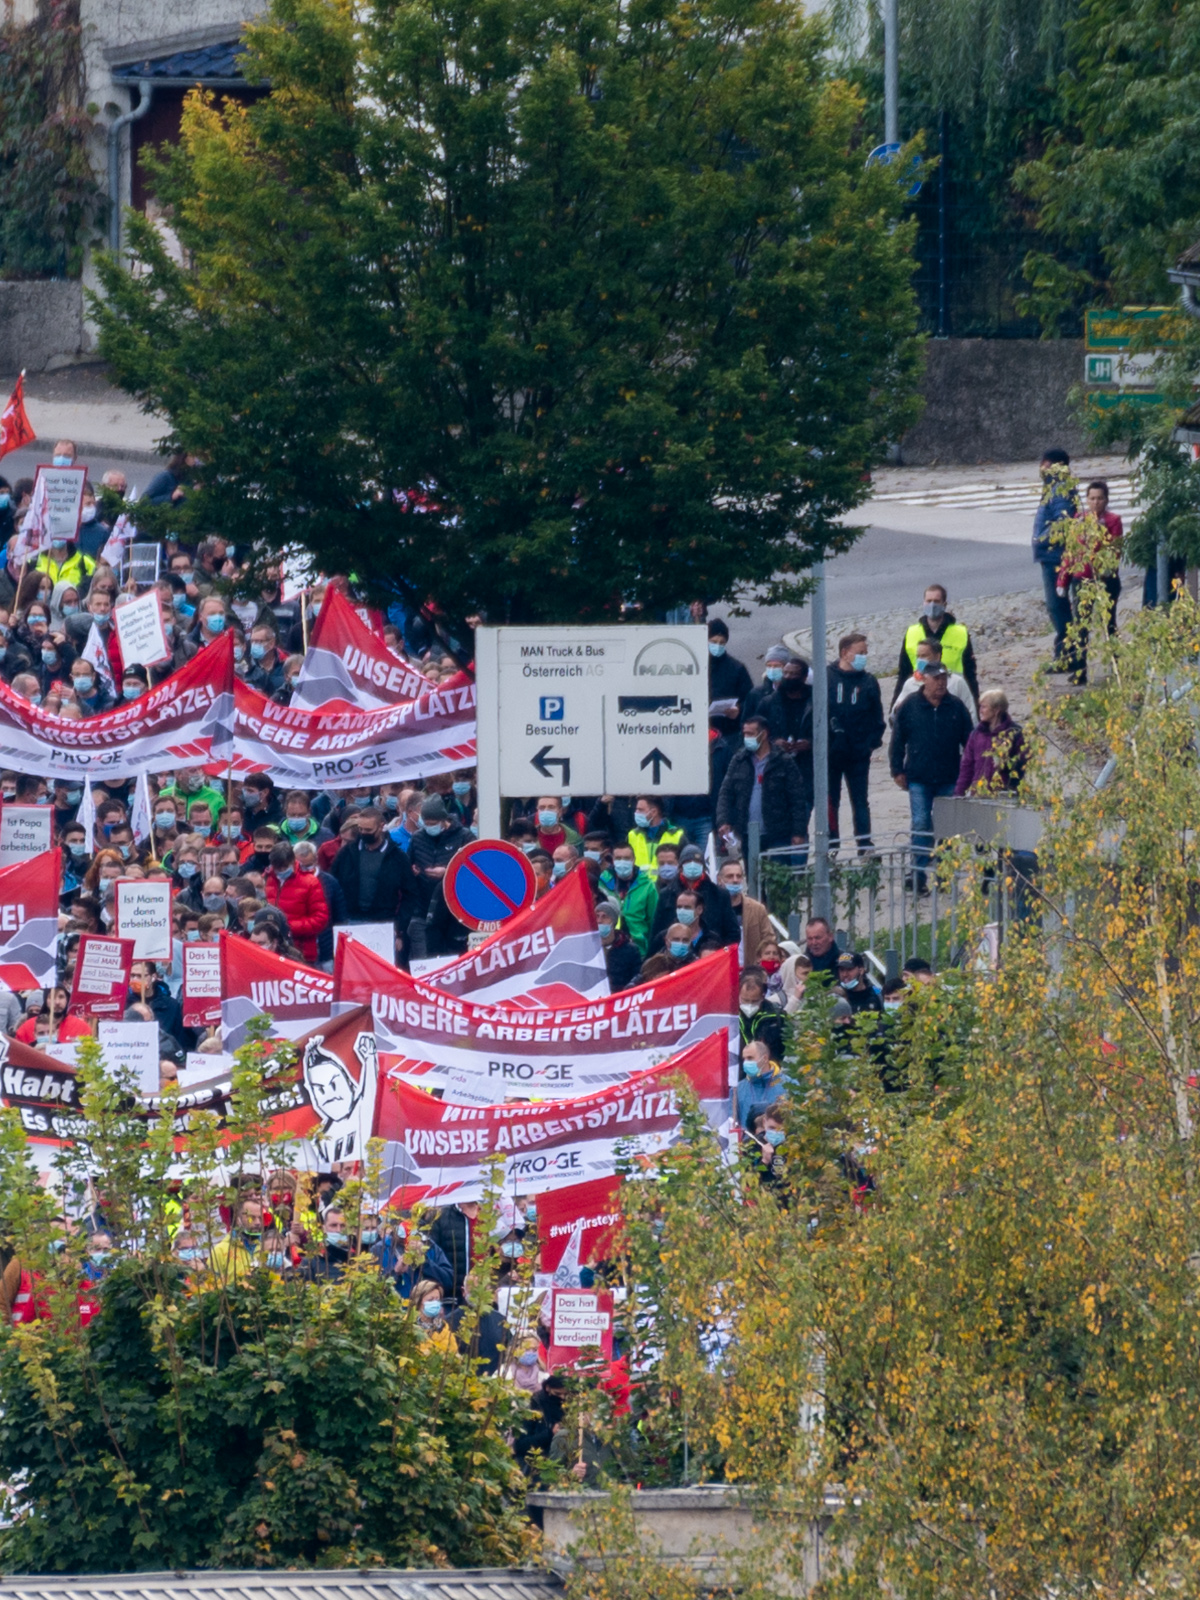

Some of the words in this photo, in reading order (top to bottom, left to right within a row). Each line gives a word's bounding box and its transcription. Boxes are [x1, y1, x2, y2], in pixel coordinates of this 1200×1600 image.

[1090, 361, 1111, 378] JH
[521, 646, 544, 656] MAN
[546, 646, 573, 656] Truck
[576, 646, 583, 656] &
[586, 646, 604, 656] Bus
[522, 664, 582, 677] Österreich
[586, 664, 604, 676] AG
[639, 664, 694, 676] MAN
[544, 698, 561, 718] P
[31, 684, 216, 746] ARBEITSPLÄTZE!
[262, 702, 310, 729] WIR
[526, 724, 579, 736] Besucher
[617, 723, 695, 734] Werkseinfahrt
[8, 818, 18, 827] Ist
[20, 820, 42, 829] Papa
[13, 831, 35, 840] dann
[1, 842, 46, 852] arbeitslos?
[124, 895, 134, 903] Ist
[136, 894, 164, 904] Mama
[133, 907, 156, 916] dann
[121, 918, 166, 928] arbeitslos?
[477, 921, 502, 931] ENDE
[88, 943, 102, 951] WIR
[104, 944, 118, 952] ALLE
[189, 952, 206, 960] Das
[102, 958, 118, 966] MAN
[98, 970, 122, 978] bleiben
[189, 968, 210, 978] Steyr
[414, 983, 464, 1014] WIR
[472, 1004, 605, 1025] KÄMPFEN
[614, 989, 655, 1012] UM
[372, 992, 470, 1036] UNSERE
[476, 1004, 697, 1042] ARBEITSPLÄTZE!
[107, 1041, 150, 1049] Arbeitsplätze
[3, 1066, 75, 1103] Habt
[20, 1107, 48, 1132] Es
[404, 1128, 490, 1156] UNSERE
[559, 1298, 576, 1307] Das
[579, 1298, 594, 1307] hat
[558, 1315, 581, 1326] Steyr
[584, 1316, 606, 1325] nicht
[557, 1332, 598, 1342] verdient!
